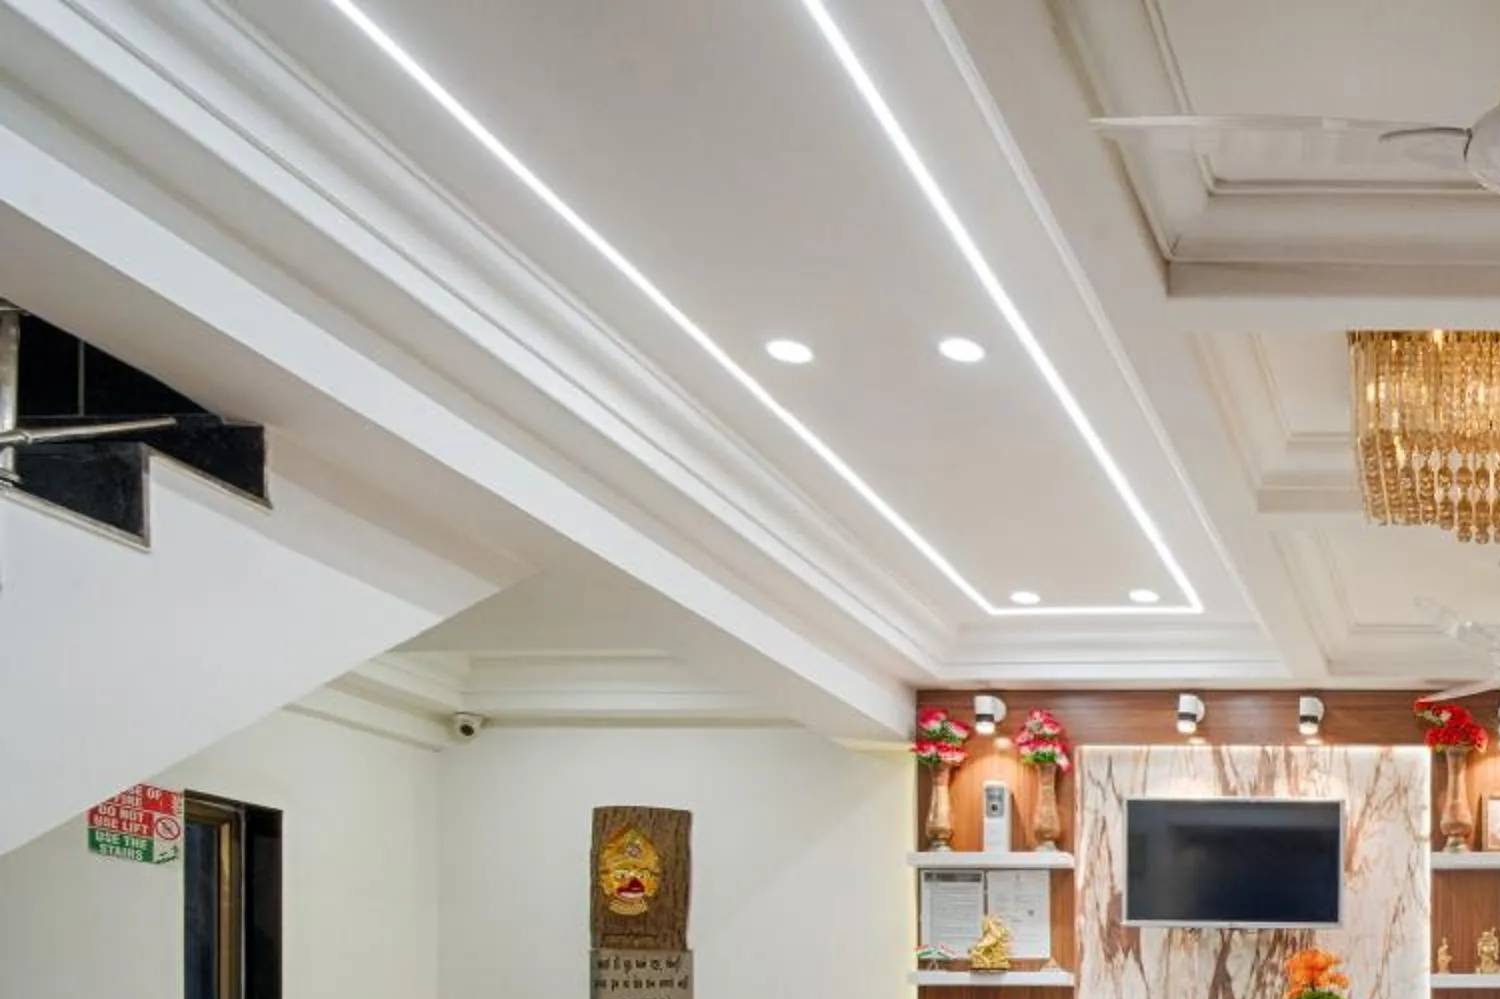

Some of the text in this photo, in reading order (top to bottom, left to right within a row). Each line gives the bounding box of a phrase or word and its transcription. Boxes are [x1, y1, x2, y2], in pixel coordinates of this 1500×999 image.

[122, 821, 149, 834] LIFT
[95, 831, 149, 850] USE THE
